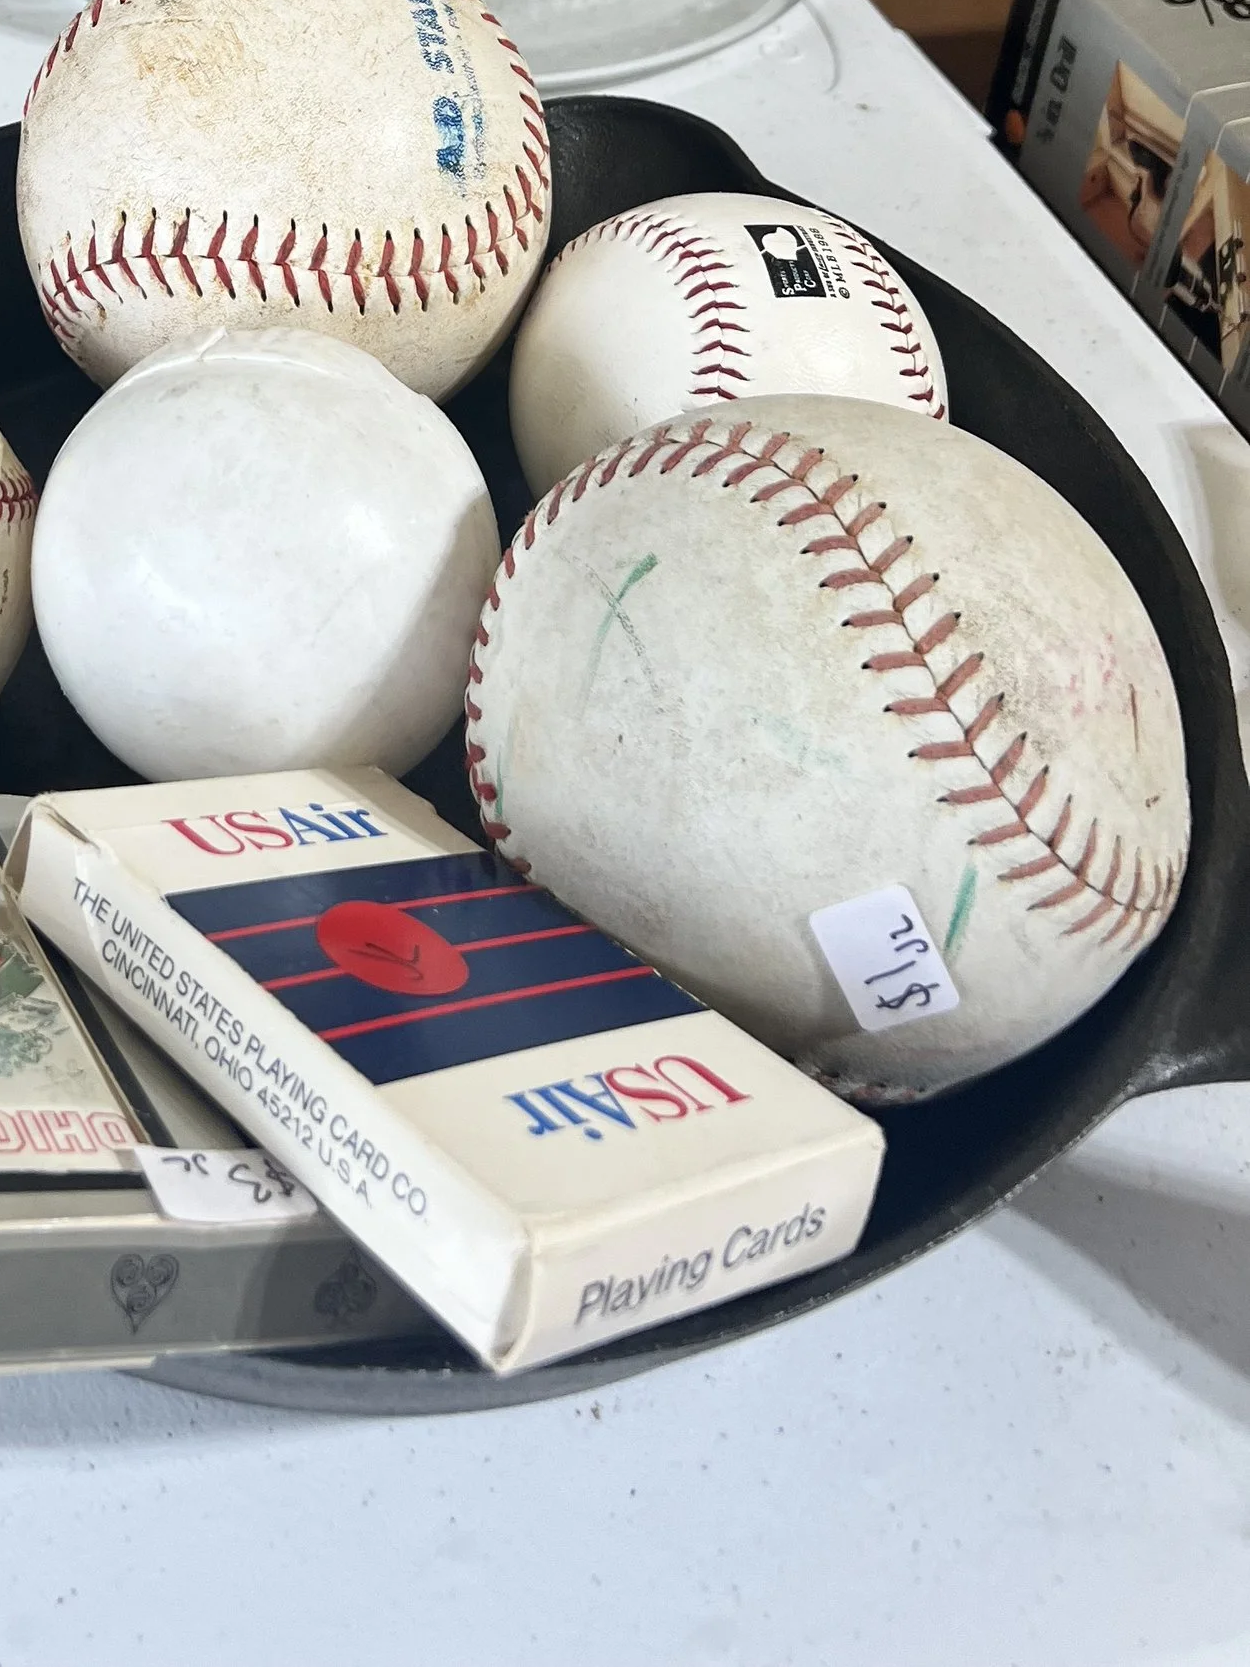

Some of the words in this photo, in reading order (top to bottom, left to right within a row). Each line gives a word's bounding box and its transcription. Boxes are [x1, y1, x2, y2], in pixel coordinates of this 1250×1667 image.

[826, 255, 847, 284] MLB
[161, 803, 388, 855] USAir
[73, 877, 111, 923] THE
[111, 910, 175, 980] UNITED
[176, 971, 244, 1046] STATES
[245, 1033, 328, 1124] PLAYING
[330, 1114, 389, 1181] CARD
[393, 1172, 429, 1224] CO.
[102, 939, 200, 1050] CINCINNATI,
[204, 1035, 254, 1092] OHIO
[257, 1086, 313, 1150] 45212
[318, 1138, 373, 1210] U.S.A.
[503, 1055, 754, 1141] USAir
[574, 1247, 714, 1326] Playing
[723, 1202, 827, 1268] Cards
